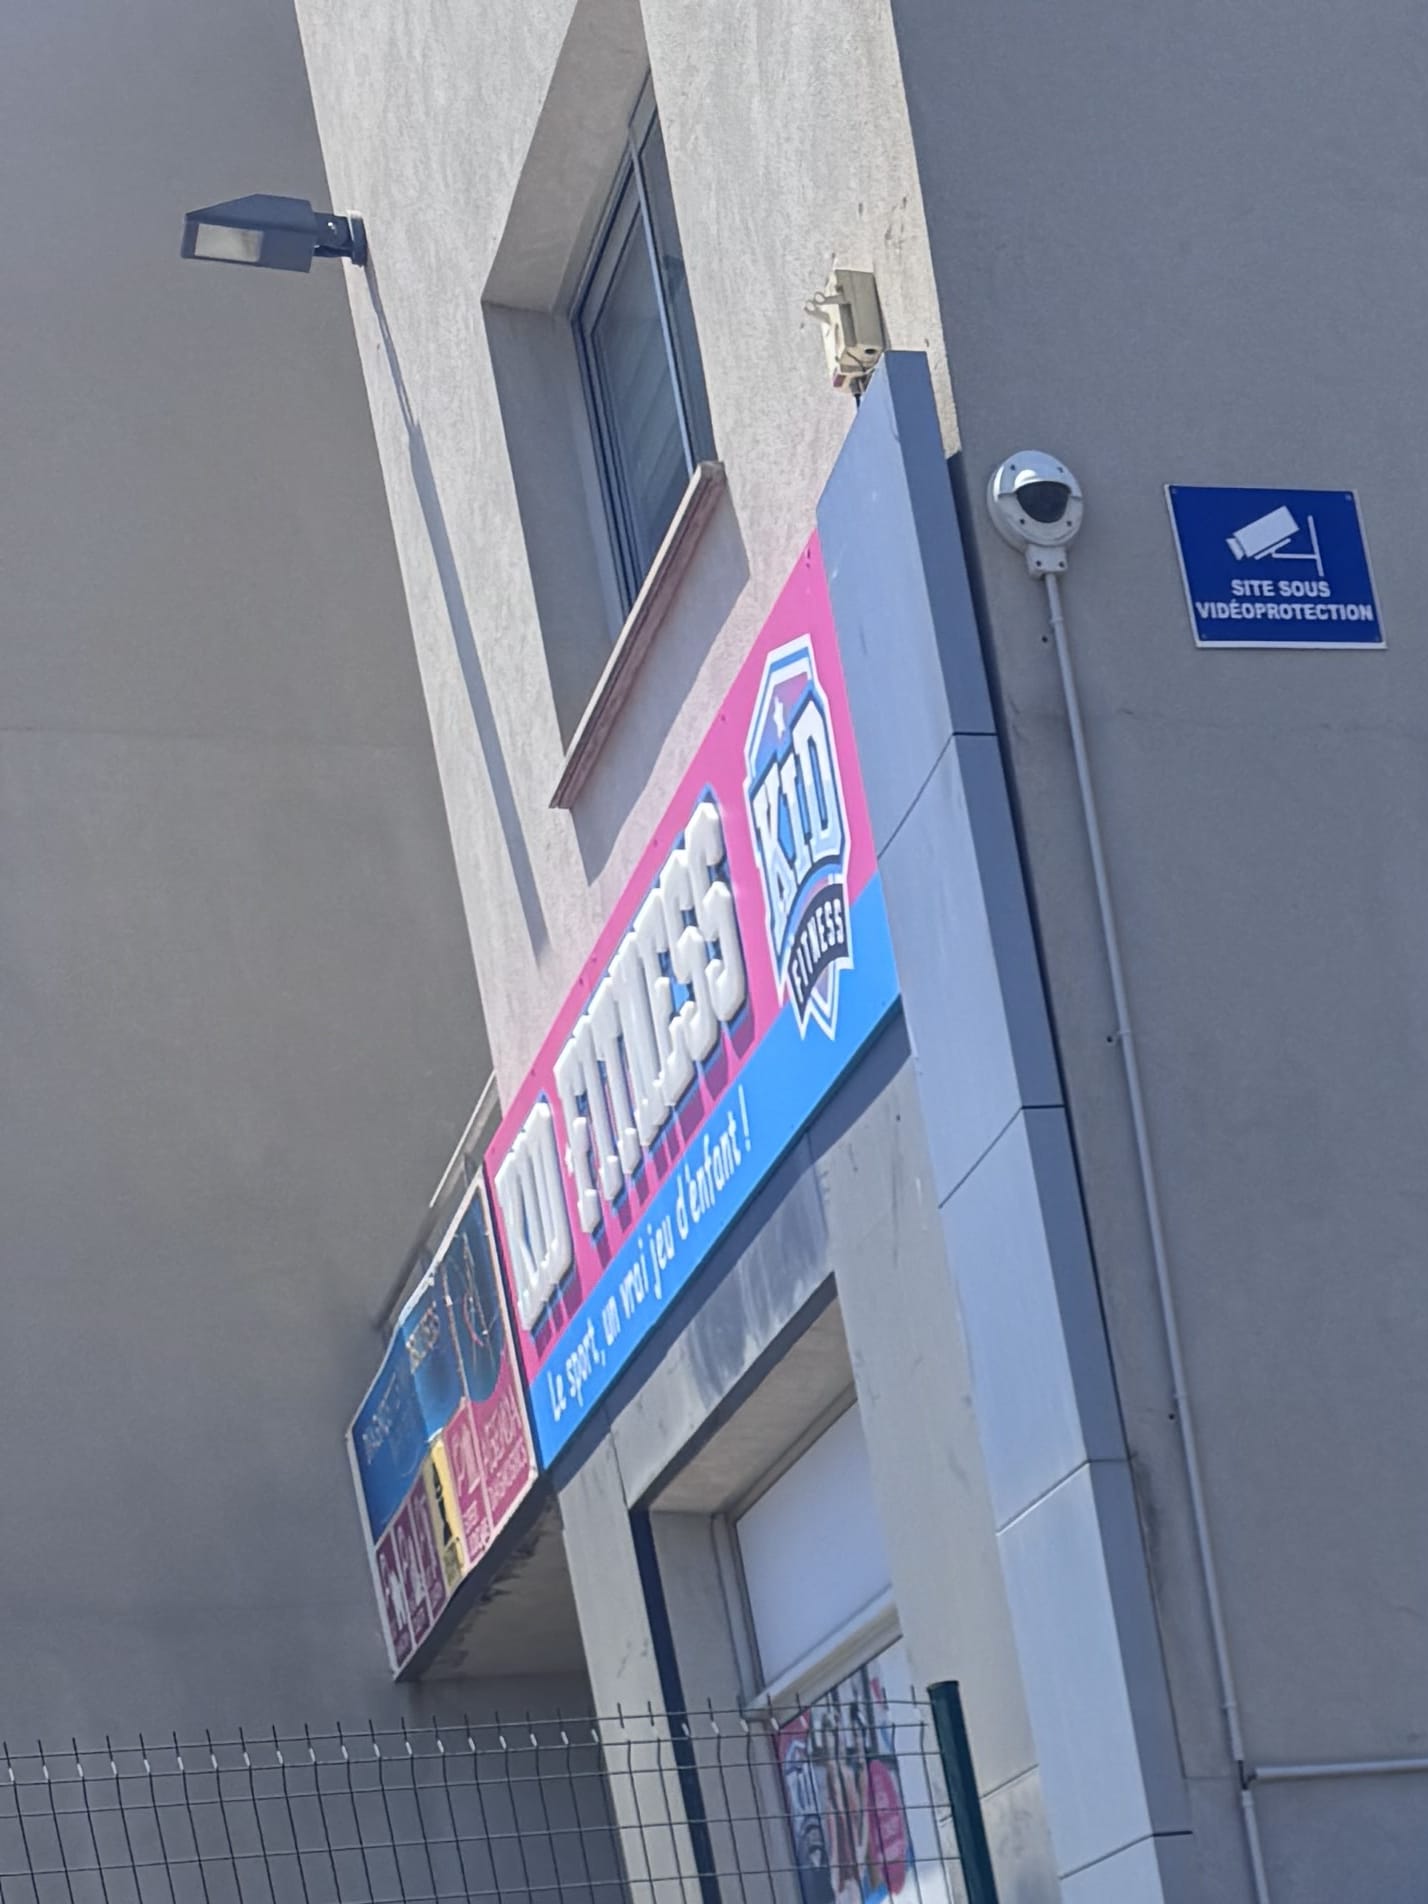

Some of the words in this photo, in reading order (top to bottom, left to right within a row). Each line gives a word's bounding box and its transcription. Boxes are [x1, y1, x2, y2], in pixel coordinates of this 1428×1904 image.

[1196, 599, 1374, 622] VIDÉOPROTECTION
[1231, 579, 1275, 597] SITE
[1279, 580, 1331, 599] SOUS
[752, 700, 843, 956] KID
[791, 898, 844, 1003] FITNESS
[495, 1102, 572, 1331] KID
[553, 803, 746, 1233] FITNESS
[547, 1371, 567, 1422] Le
[565, 1317, 606, 1408] sport,
[602, 1296, 621, 1346] un
[619, 1236, 649, 1320] vrai
[646, 1215, 675, 1300] jeu
[676, 1110, 741, 1241] d'enfant
